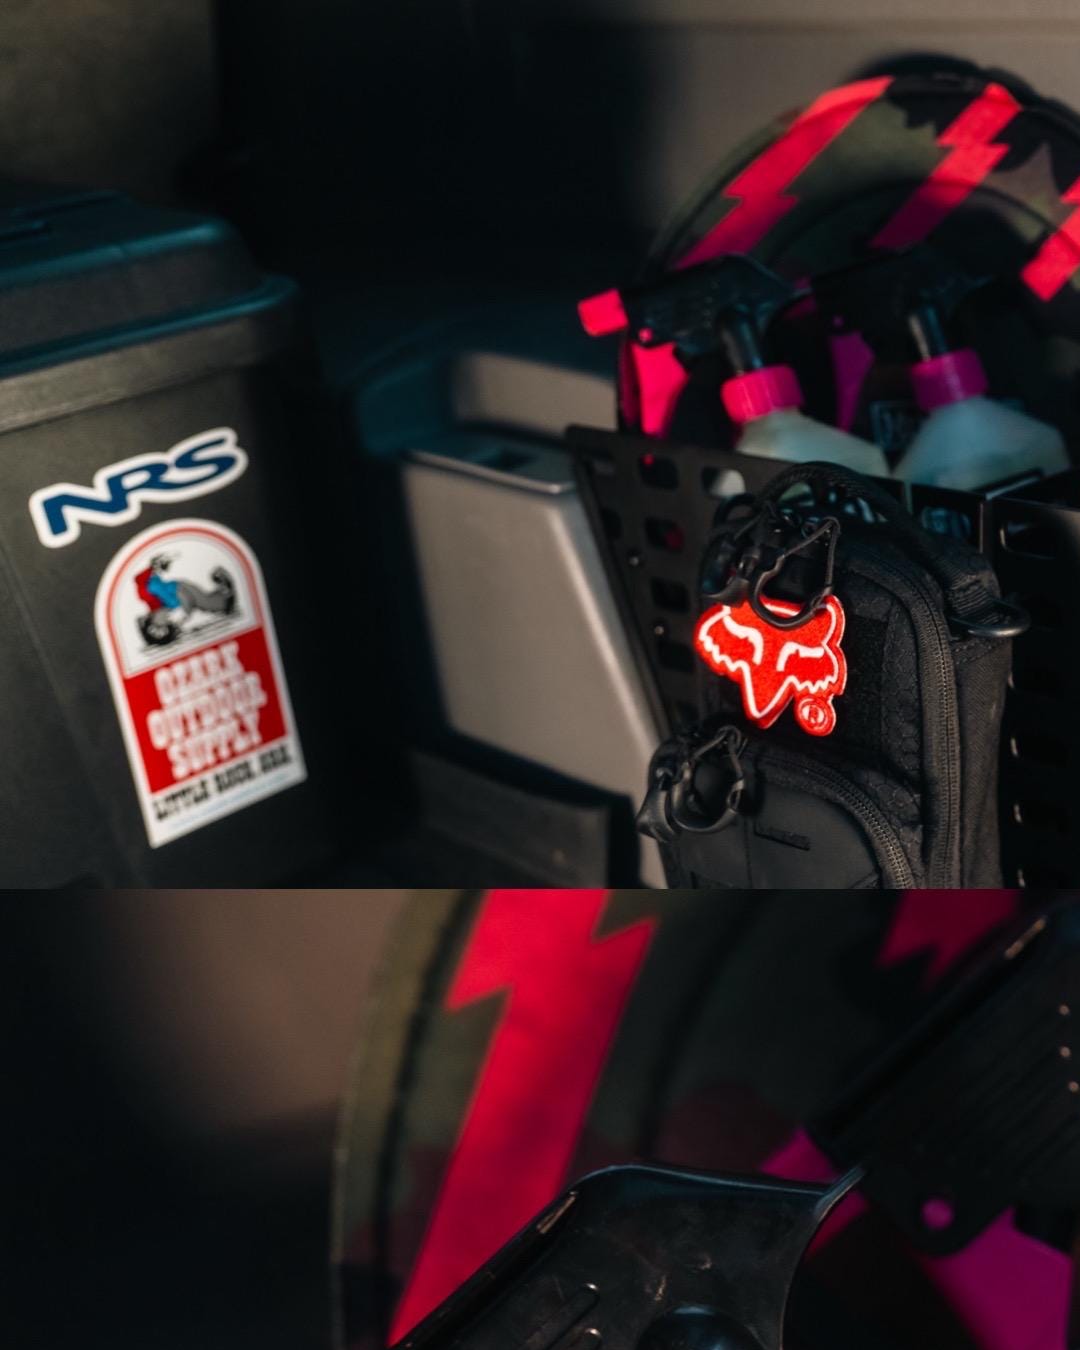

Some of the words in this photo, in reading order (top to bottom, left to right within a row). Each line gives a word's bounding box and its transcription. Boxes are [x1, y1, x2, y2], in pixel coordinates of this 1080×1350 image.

[41, 436, 238, 536] NRS
[155, 641, 244, 699] OZARK
[147, 671, 268, 750] OUTDOOR
[167, 710, 263, 779] SUPPLY
